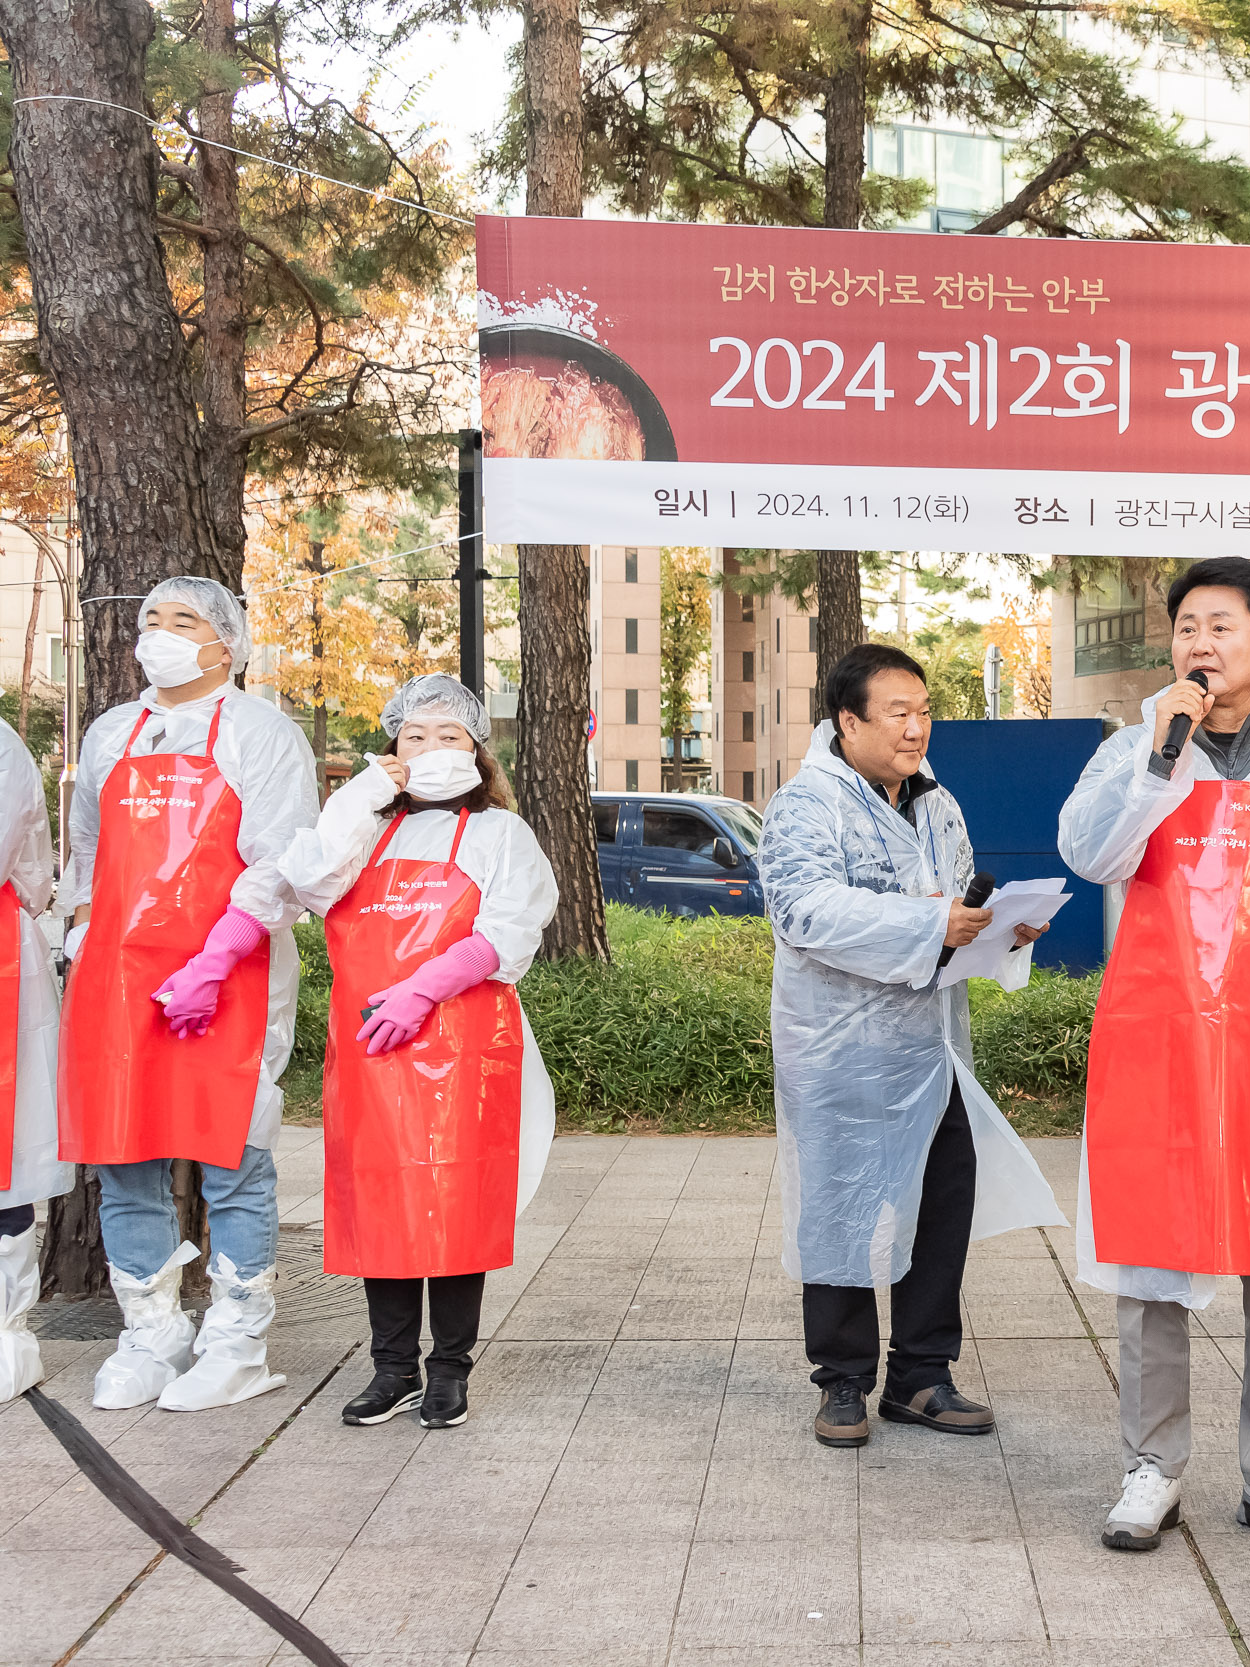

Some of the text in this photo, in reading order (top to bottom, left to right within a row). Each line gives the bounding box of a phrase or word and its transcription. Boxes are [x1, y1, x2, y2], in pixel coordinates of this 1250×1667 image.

[712, 263, 1110, 315] 김치 한상자로 전하는 안부
[709, 336, 895, 411] 2024
[915, 333, 1131, 434] 제2회
[654, 488, 709, 518] 일시
[757, 493, 830, 517] 2024.
[843, 495, 879, 518] 11.
[893, 494, 970, 523] 12(화)
[1013, 497, 1070, 526] 장소
[1217, 827, 1236, 835] 2024
